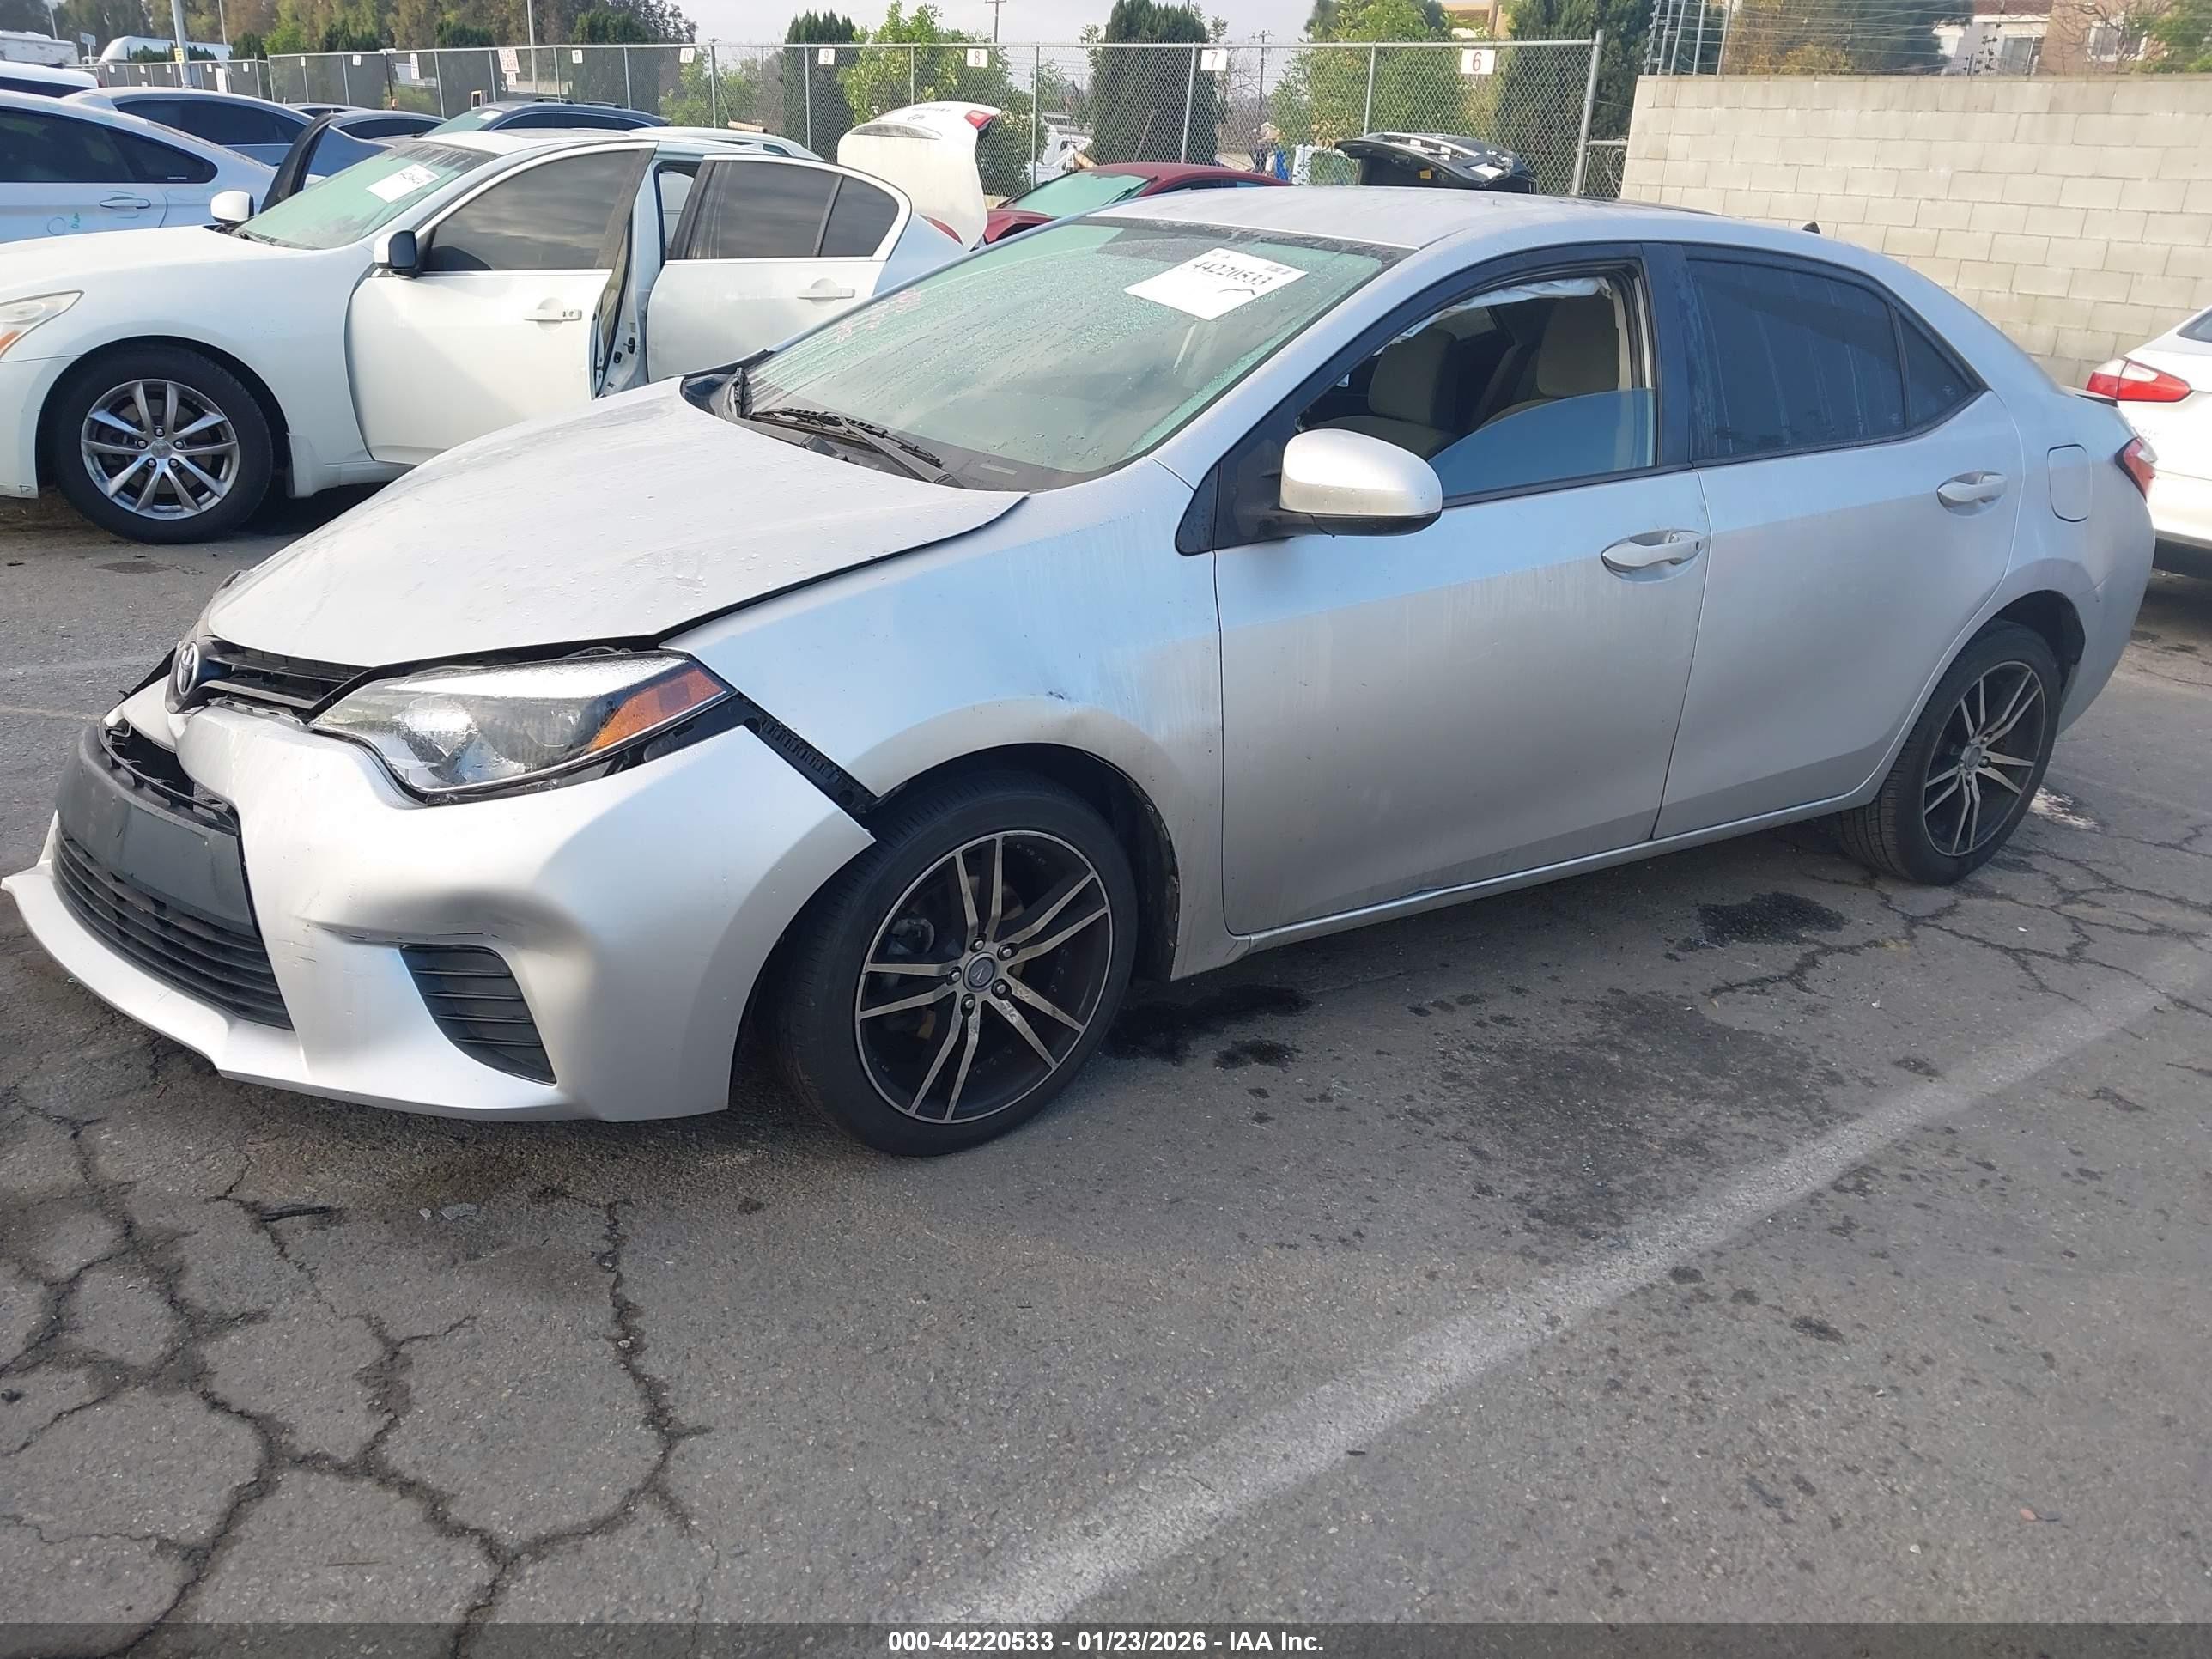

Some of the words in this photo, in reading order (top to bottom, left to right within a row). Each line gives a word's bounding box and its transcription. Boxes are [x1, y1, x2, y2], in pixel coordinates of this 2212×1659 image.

[974, 50, 981, 65] 8
[1211, 51, 1218, 70] 7
[1472, 51, 1482, 72] 6
